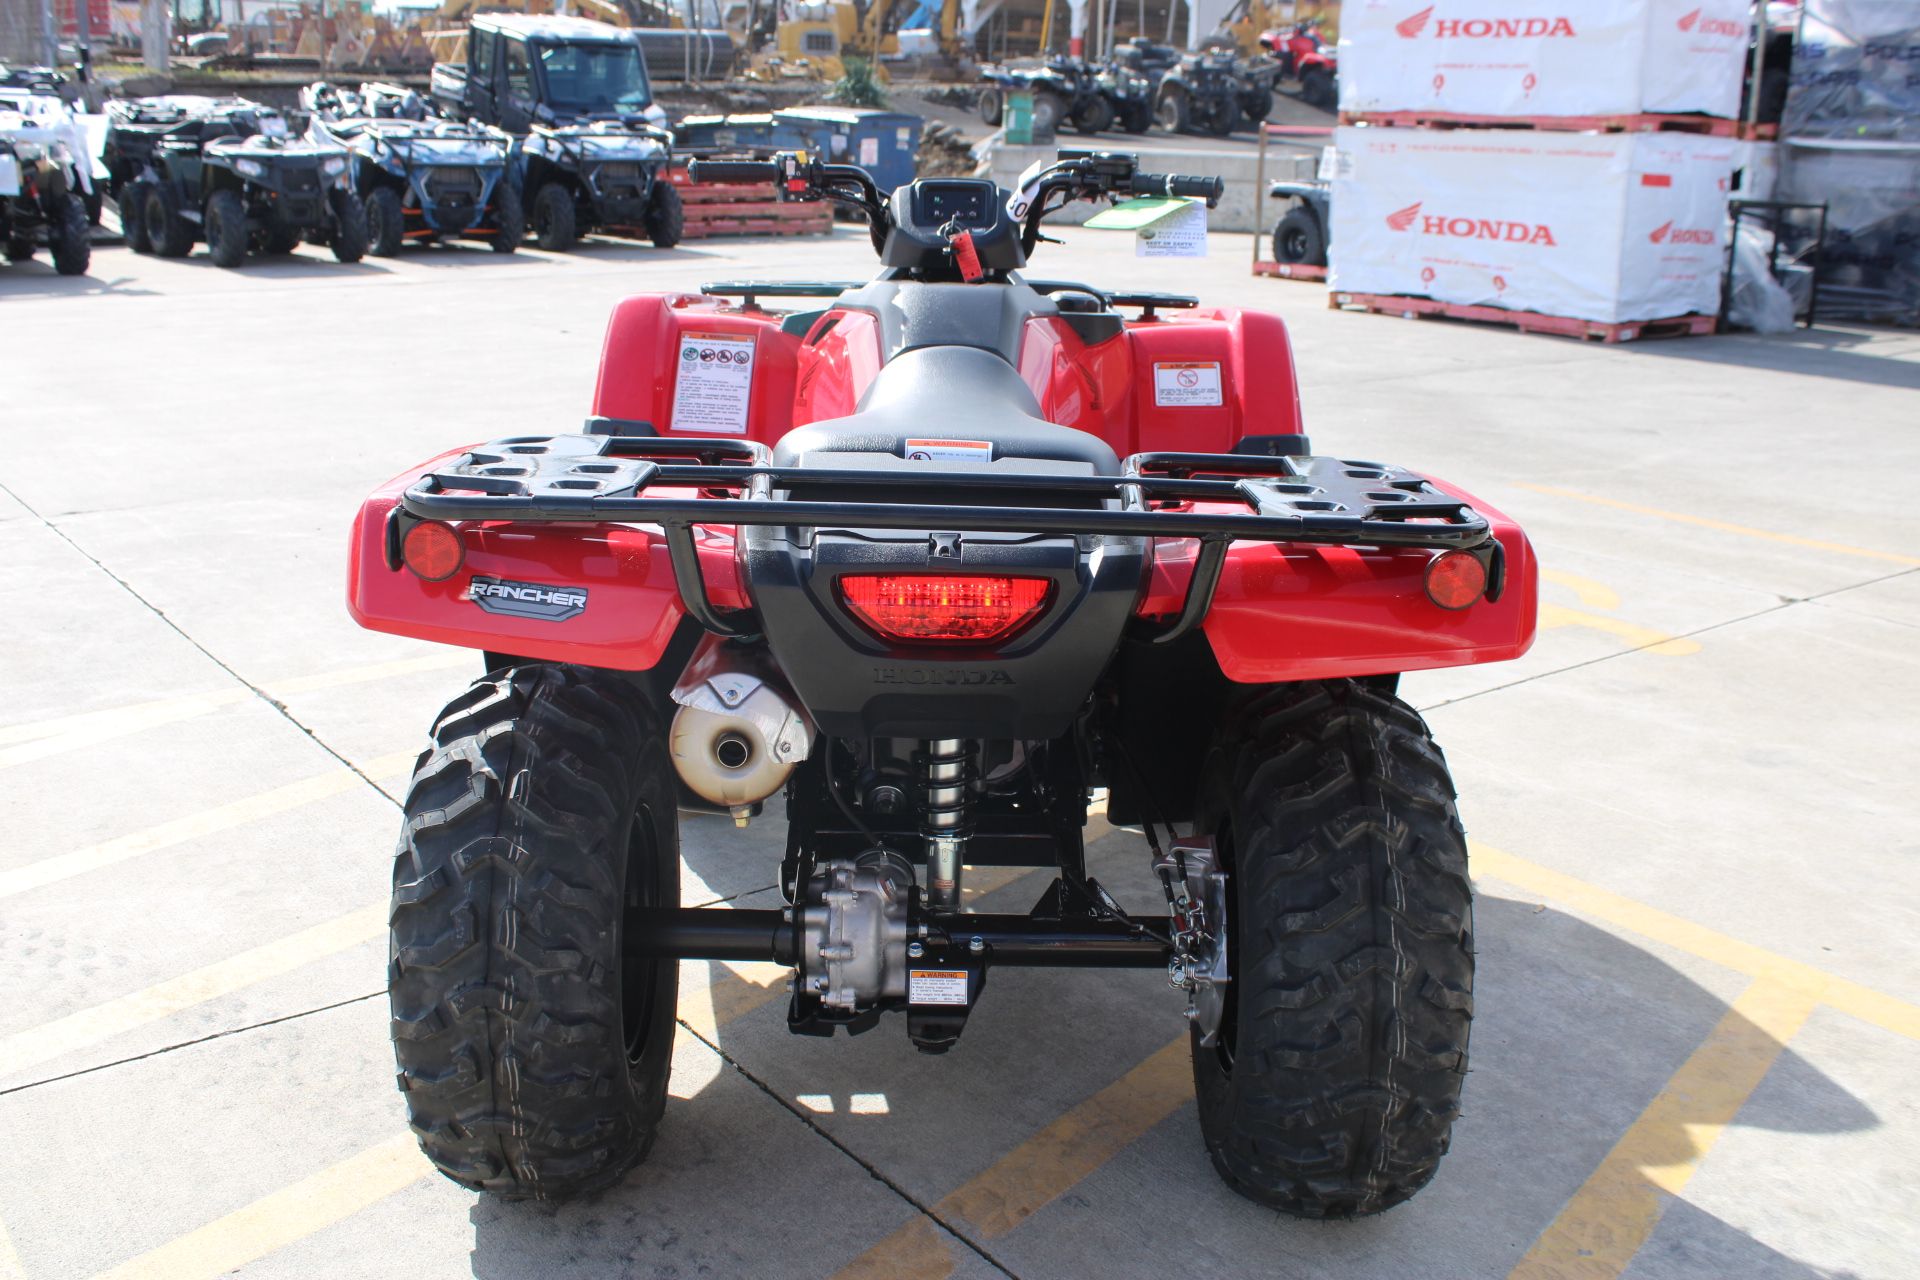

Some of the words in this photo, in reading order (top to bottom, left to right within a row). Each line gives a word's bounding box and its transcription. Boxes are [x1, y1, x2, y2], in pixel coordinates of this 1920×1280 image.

[1434, 18, 1576, 38] HONDA
[1698, 17, 1746, 37] HONDA
[1423, 215, 1557, 246] HONDA
[1670, 228, 1716, 245] HONDA
[469, 582, 587, 608] RANCHER
[873, 667, 1017, 685] HONDA
